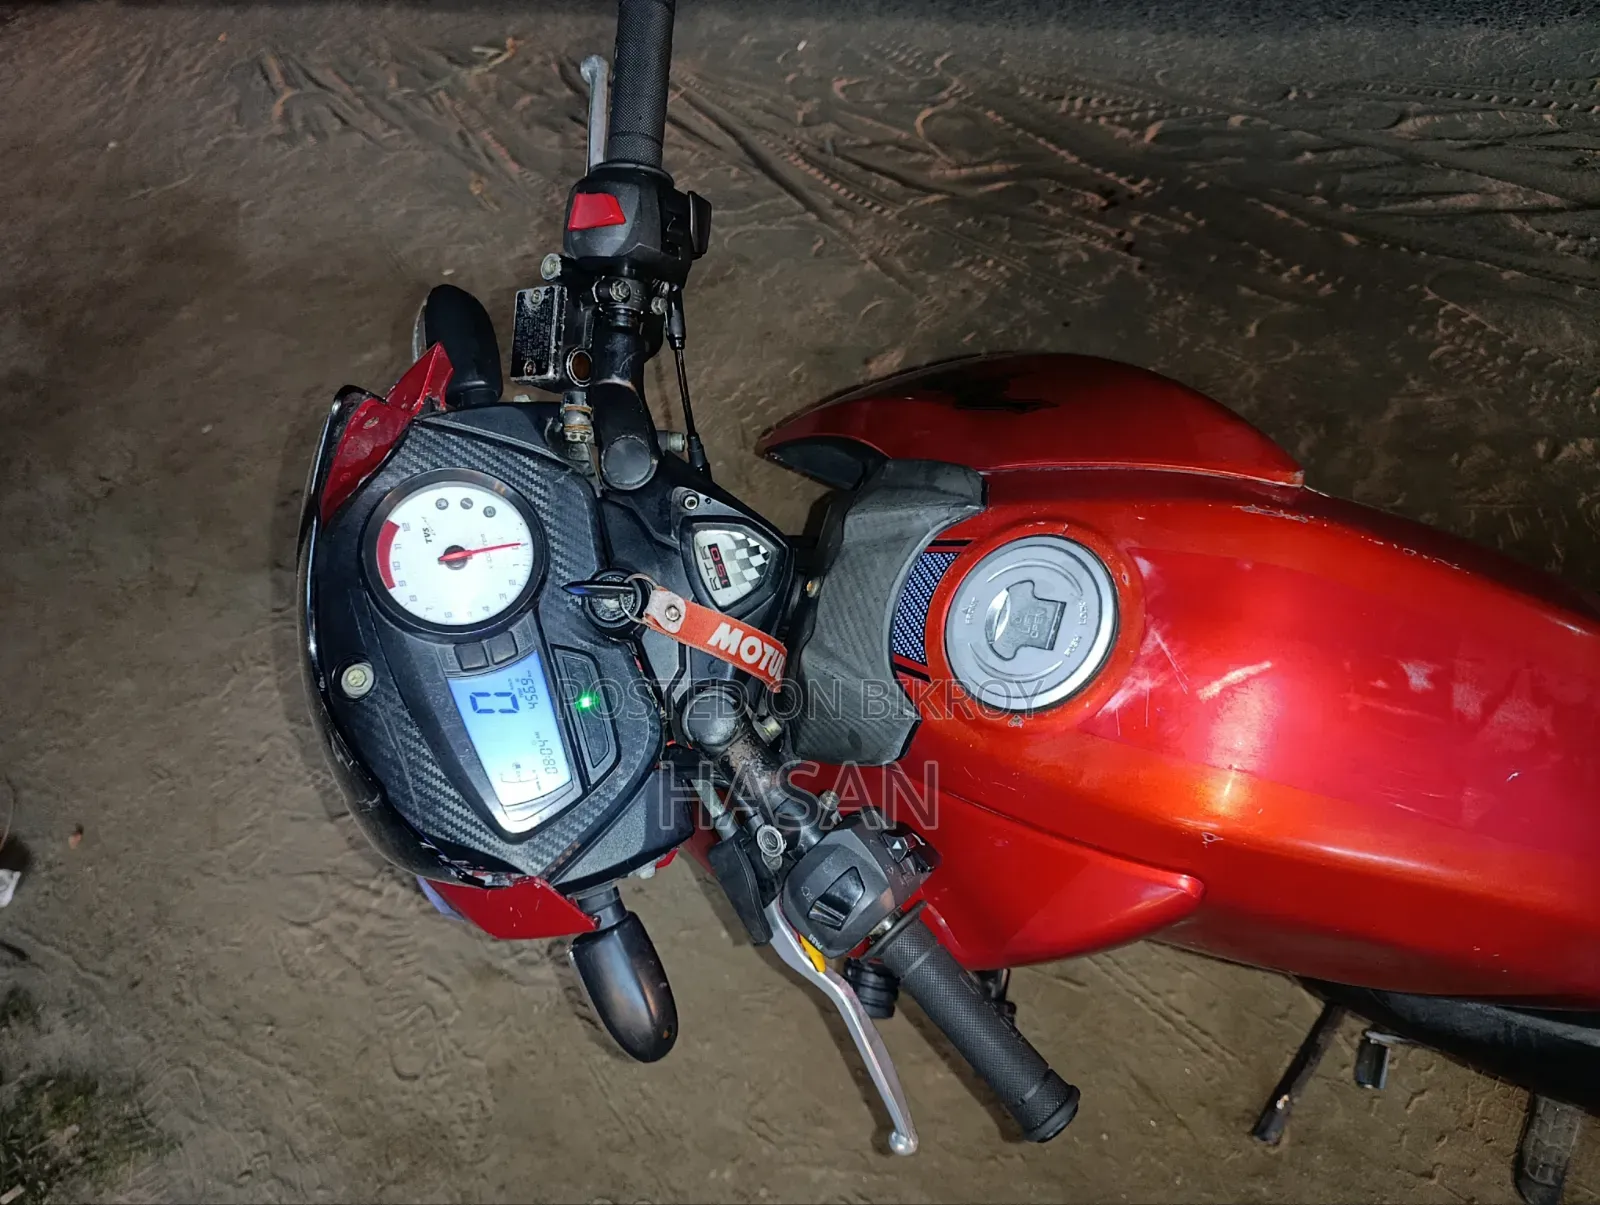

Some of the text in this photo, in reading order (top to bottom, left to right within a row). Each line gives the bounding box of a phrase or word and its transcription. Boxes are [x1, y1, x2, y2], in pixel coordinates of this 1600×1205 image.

[401, 522, 411, 532] 12
[422, 527, 432, 543] TVS
[392, 561, 401, 571] 10
[699, 545, 721, 592] RTR
[710, 546, 729, 586] 150
[469, 691, 520, 715] 0
[537, 739, 559, 775] 08:04
